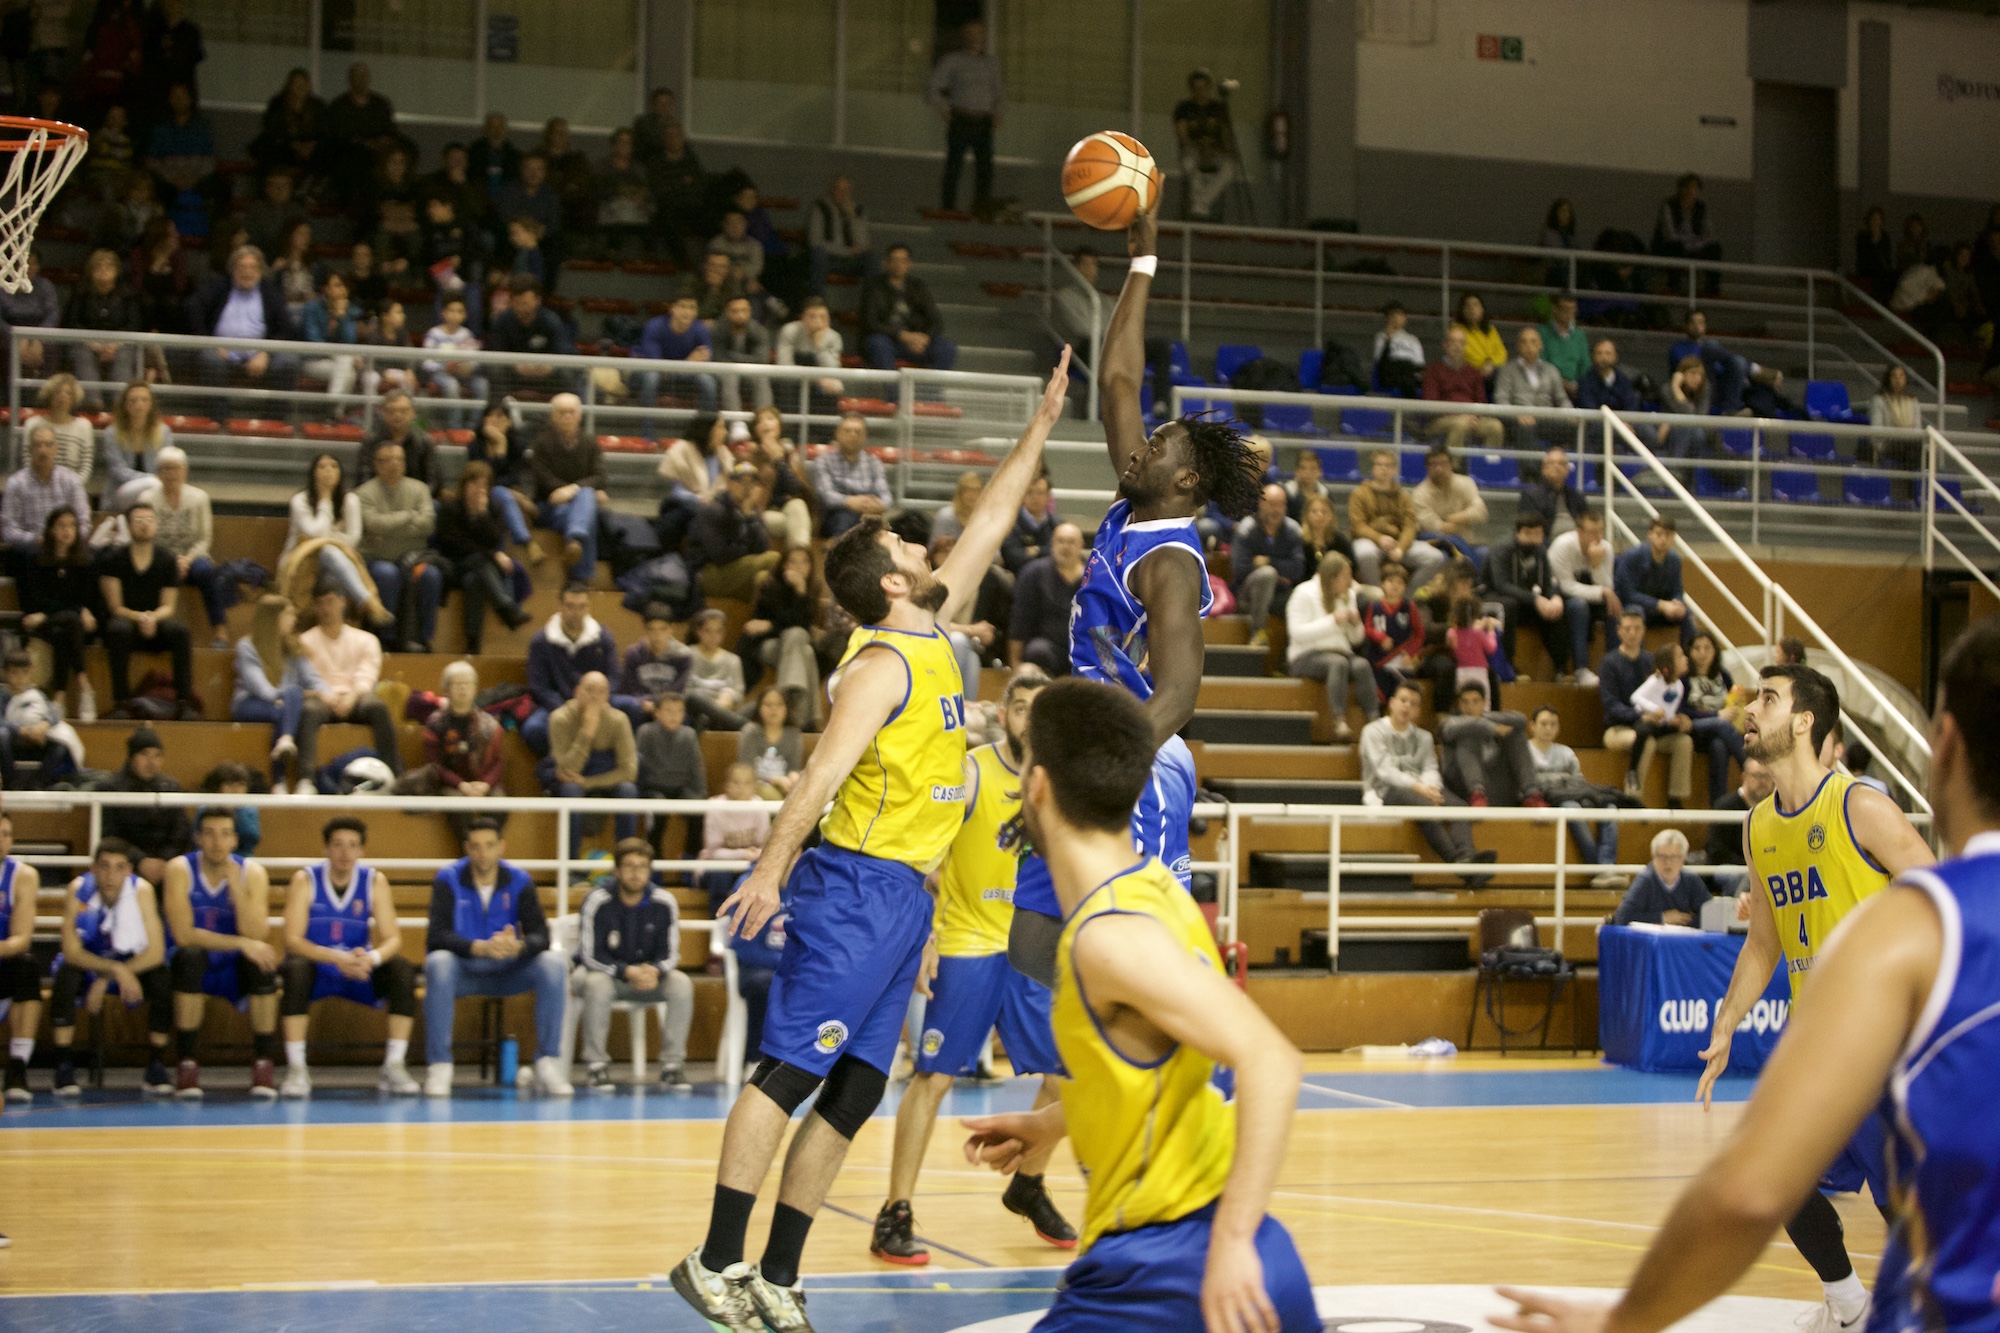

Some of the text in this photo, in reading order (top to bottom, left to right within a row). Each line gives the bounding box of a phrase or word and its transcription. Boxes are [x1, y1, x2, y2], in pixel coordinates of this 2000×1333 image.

[1767, 865, 1829, 908] BBA
[1798, 913, 1809, 947] 4
[1659, 998, 1709, 1034] CLUB
